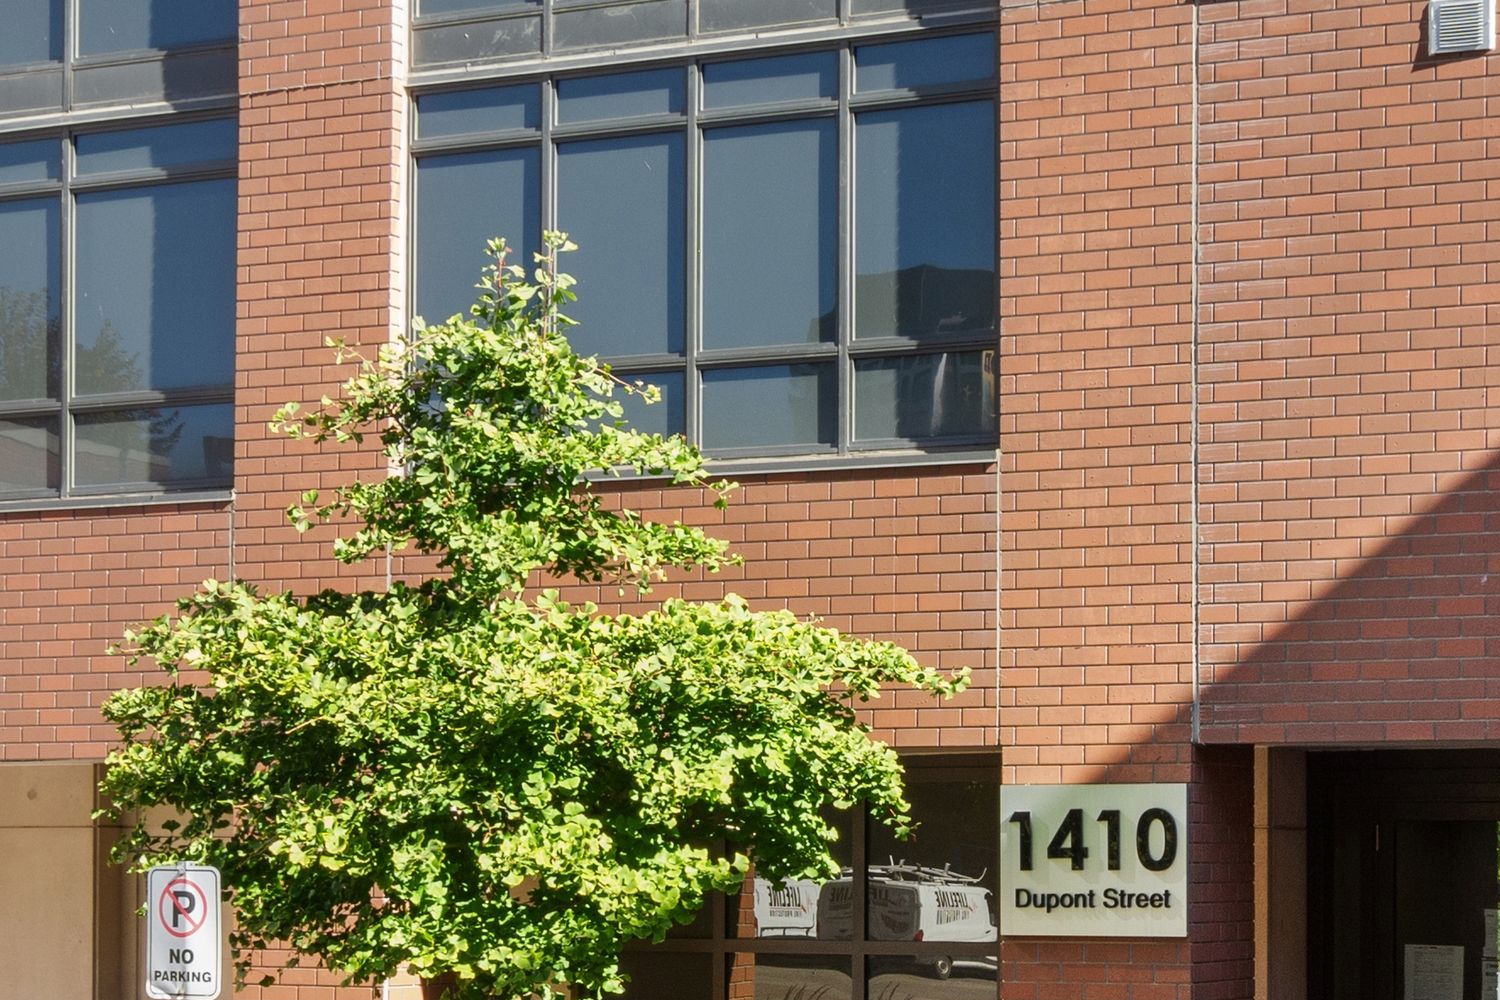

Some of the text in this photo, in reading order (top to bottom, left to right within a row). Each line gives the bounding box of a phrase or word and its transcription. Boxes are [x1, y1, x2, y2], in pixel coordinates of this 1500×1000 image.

[1009, 807, 1178, 872] 1410
[1014, 887, 1171, 913] Dupont Street
[169, 948, 194, 965] NO
[154, 970, 212, 983] PARKING
